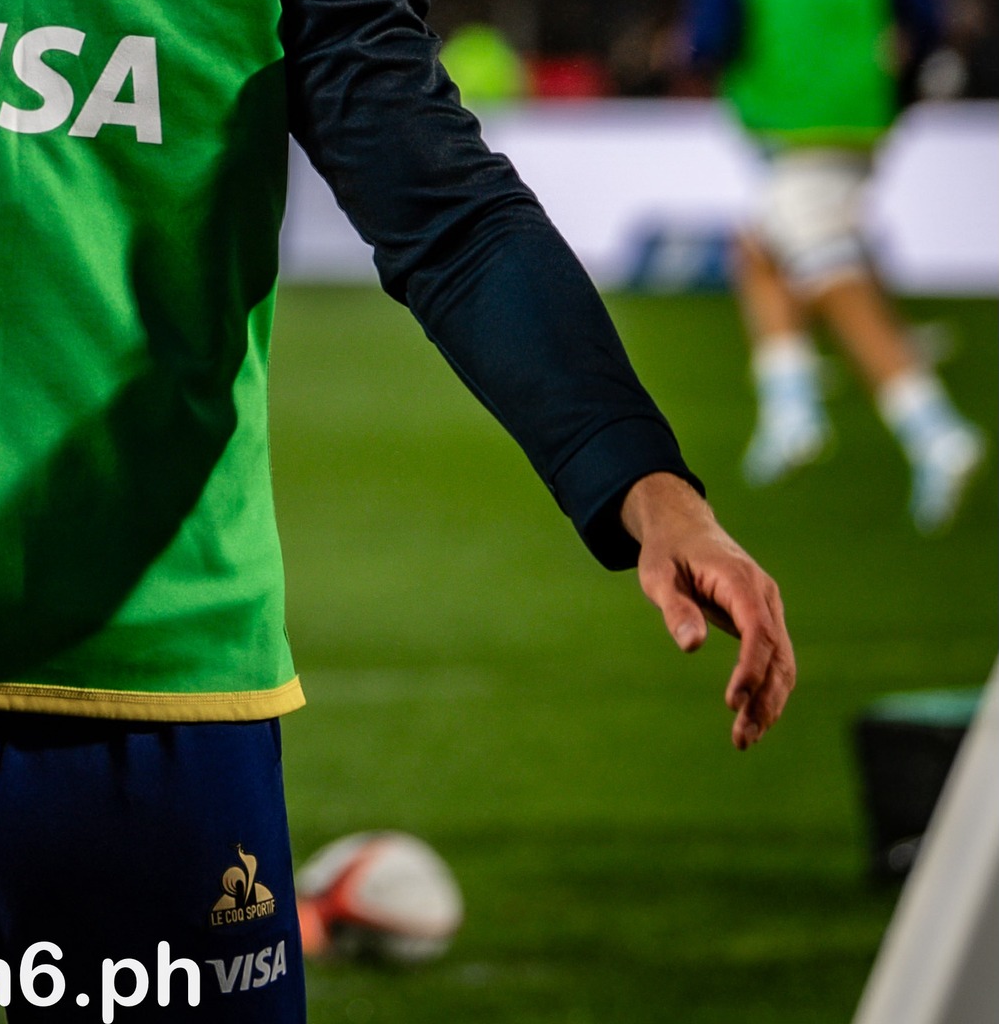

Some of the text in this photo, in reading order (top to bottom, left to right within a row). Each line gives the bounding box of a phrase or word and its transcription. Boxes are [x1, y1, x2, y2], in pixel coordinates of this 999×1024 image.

[211, 899, 275, 926] LE COQ SPORTIF
[205, 940, 286, 993] VISA
